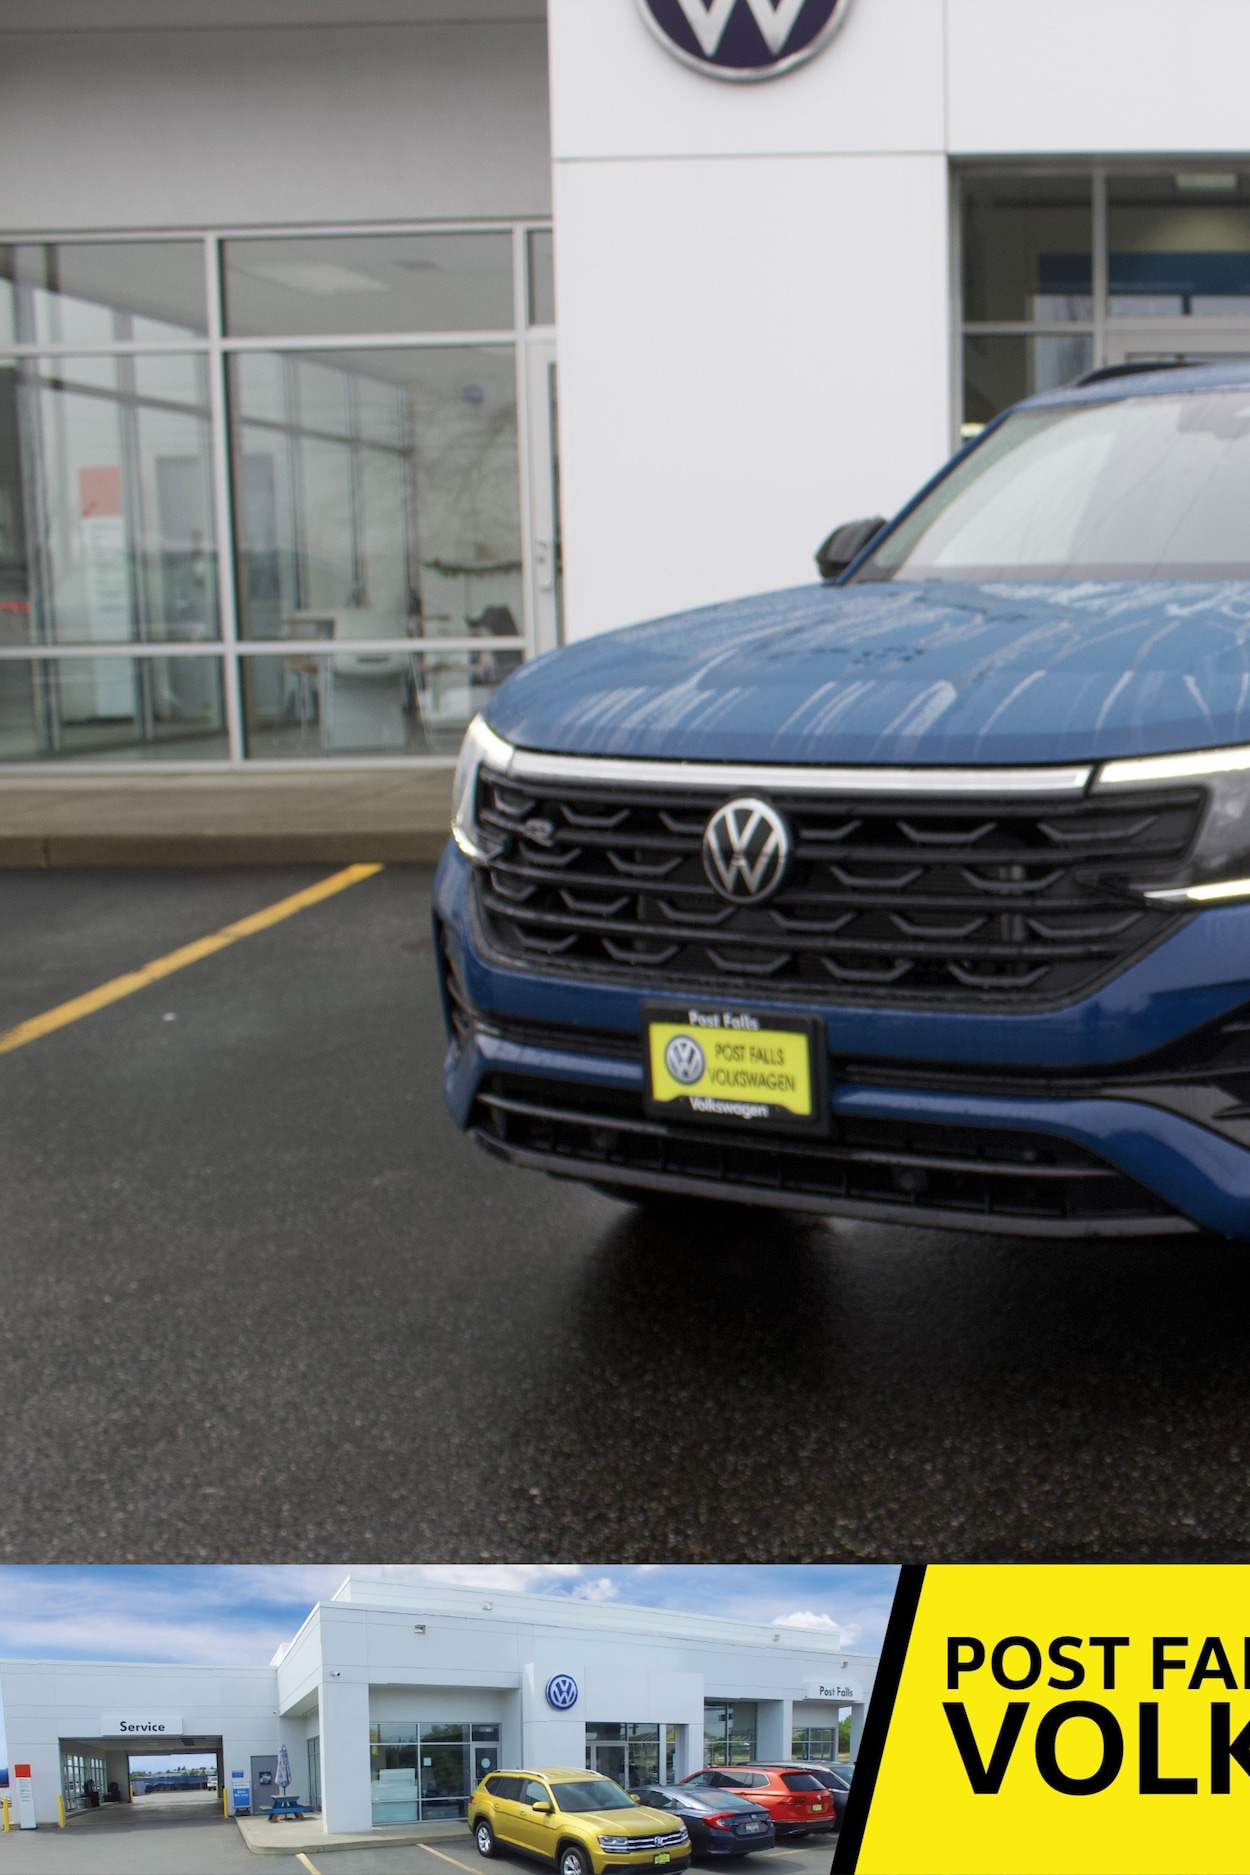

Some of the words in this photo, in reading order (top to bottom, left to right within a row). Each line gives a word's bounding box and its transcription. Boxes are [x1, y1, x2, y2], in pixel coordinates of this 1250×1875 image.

[688, 1009, 721, 1028] Post
[722, 1012, 761, 1030] Falls
[715, 1043, 746, 1064] POST
[749, 1047, 784, 1065] FALLS
[708, 1067, 797, 1092] VOLKSWAGEN
[688, 1095, 770, 1119] Volkswagen
[819, 1685, 835, 1697] Post
[836, 1687, 853, 1697] Falls
[119, 1720, 166, 1732] Service
